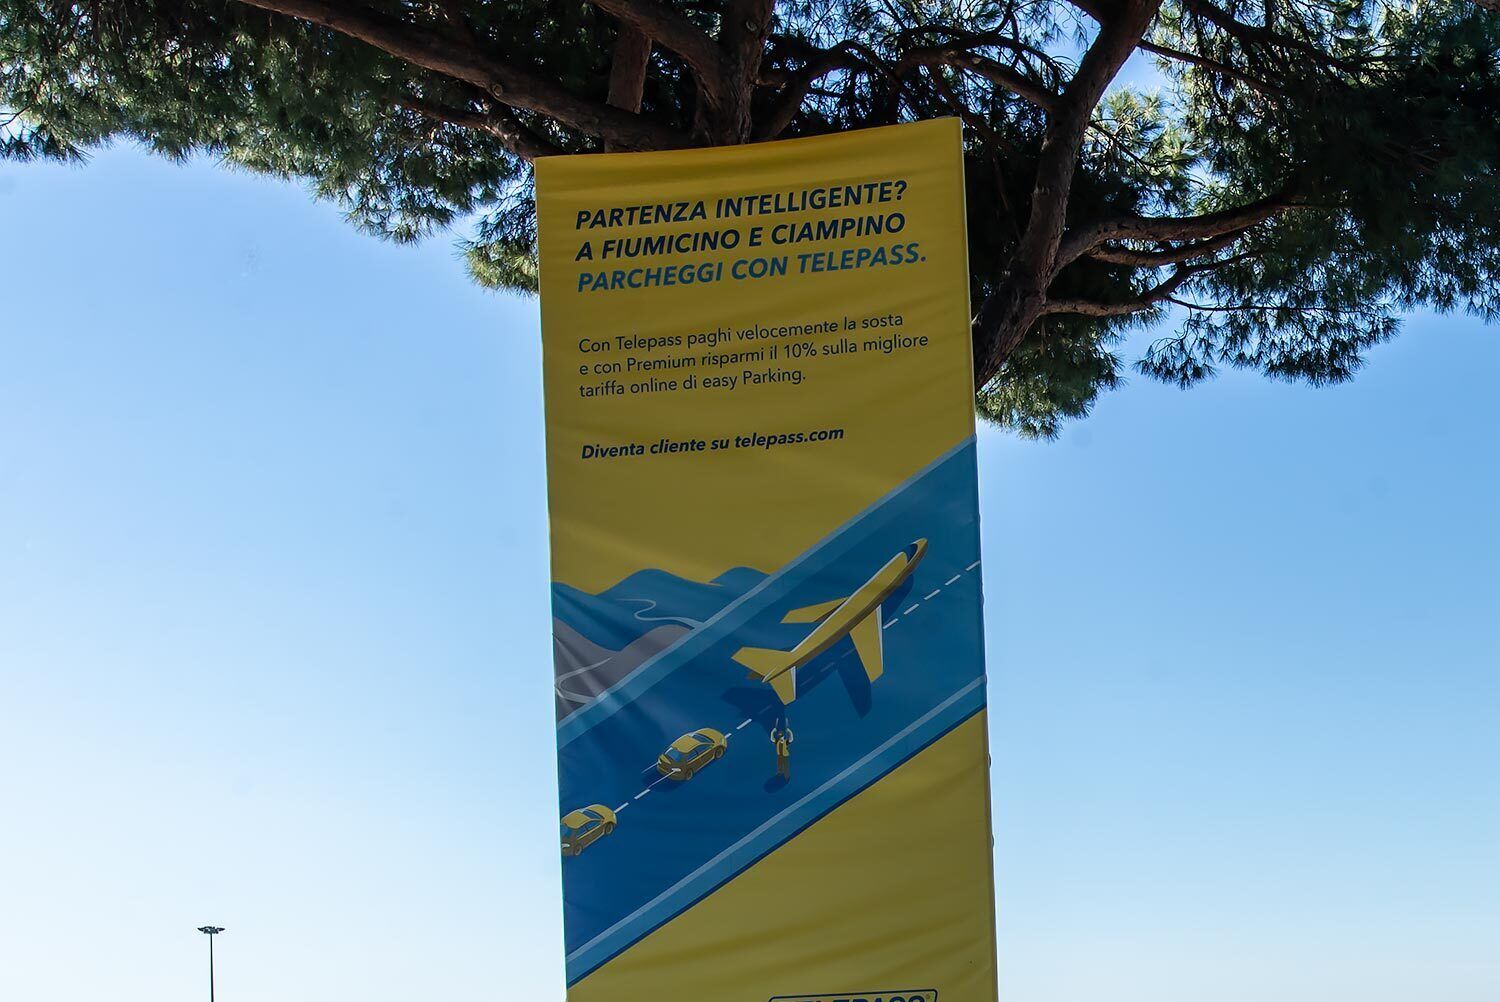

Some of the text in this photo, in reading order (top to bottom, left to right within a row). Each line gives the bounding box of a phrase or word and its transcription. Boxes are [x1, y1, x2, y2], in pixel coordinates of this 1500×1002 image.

[576, 180, 908, 230] PARTENZA INTELLIGENTE?
[575, 212, 906, 262] A FIUMICINO E CIAMPINO
[577, 242, 927, 293] PARCHEGGI CON TELEPASS.
[579, 313, 903, 353] Con Telepass paghi velocemente la sosta
[579, 333, 929, 375] e con Premium risparmi il 10% sulla migliore
[579, 367, 806, 397] tariffa online di easy Parking.
[581, 428, 844, 460] Diventa cliente su telepass.com
